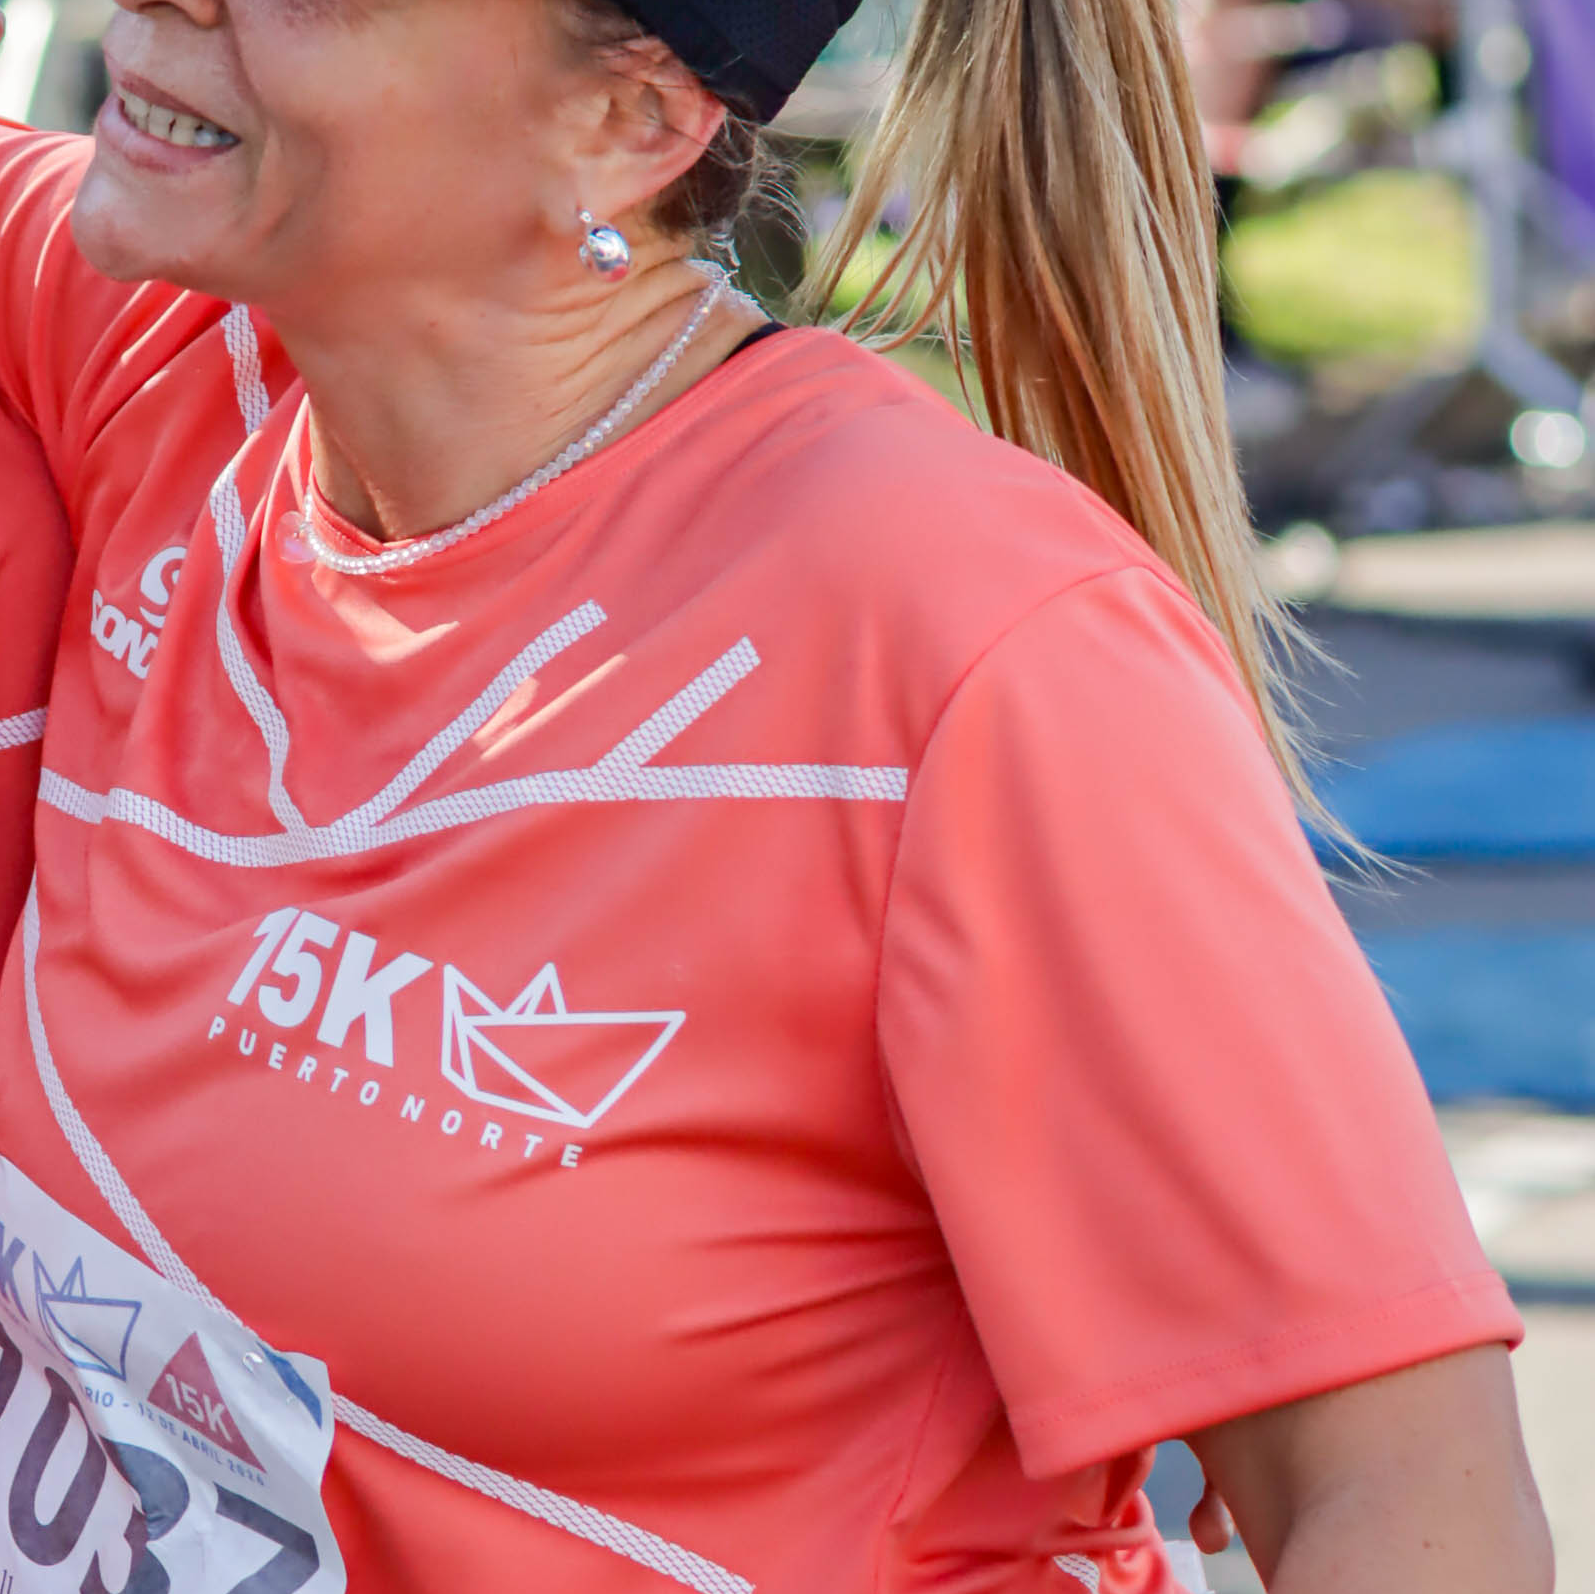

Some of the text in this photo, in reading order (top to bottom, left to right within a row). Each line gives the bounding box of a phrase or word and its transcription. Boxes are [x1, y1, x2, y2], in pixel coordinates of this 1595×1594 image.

[227, 906, 434, 1069] 15K
[208, 1016, 583, 1168] PUERTO NORTE
[165, 1373, 234, 1443] 15K
[182, 1429, 223, 1465] ABRIL
